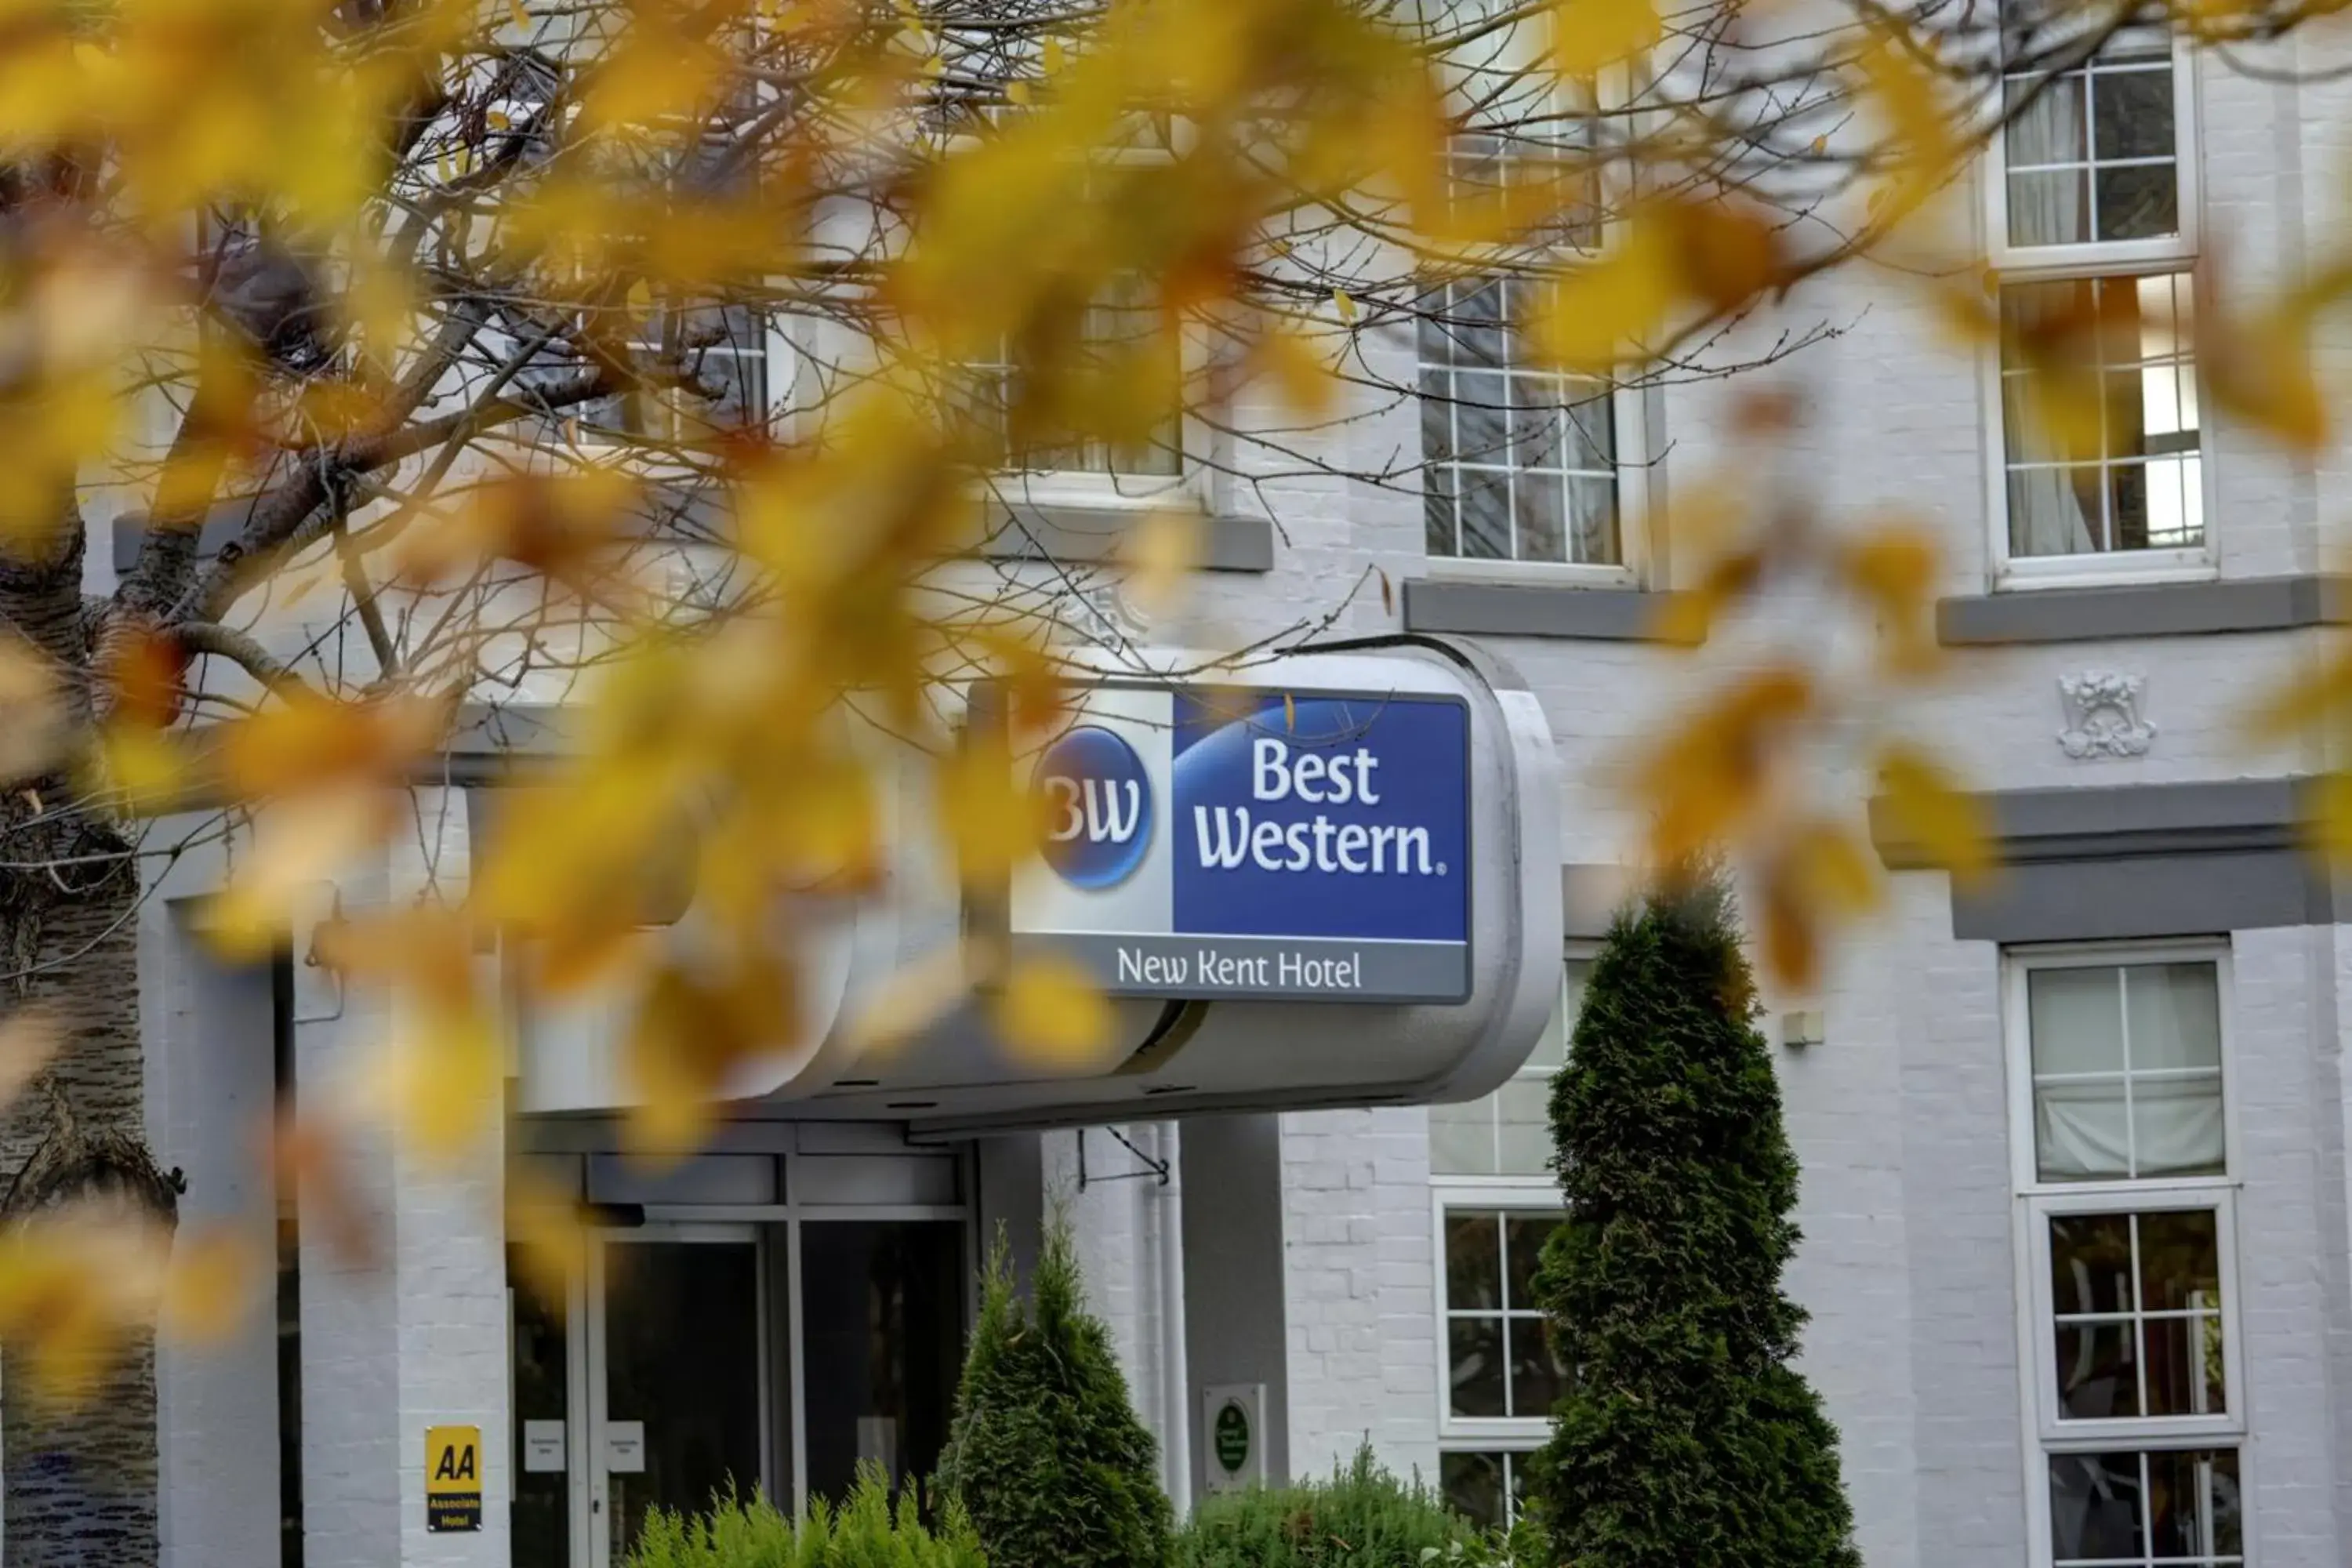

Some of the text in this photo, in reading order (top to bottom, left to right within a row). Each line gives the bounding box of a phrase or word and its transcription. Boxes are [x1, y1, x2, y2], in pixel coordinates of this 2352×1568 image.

[1254, 738, 1380, 805] Best
[1117, 947, 1361, 988] New Kent Hotel
[434, 1444, 474, 1481] AA
[441, 1514, 469, 1527] Hotel
